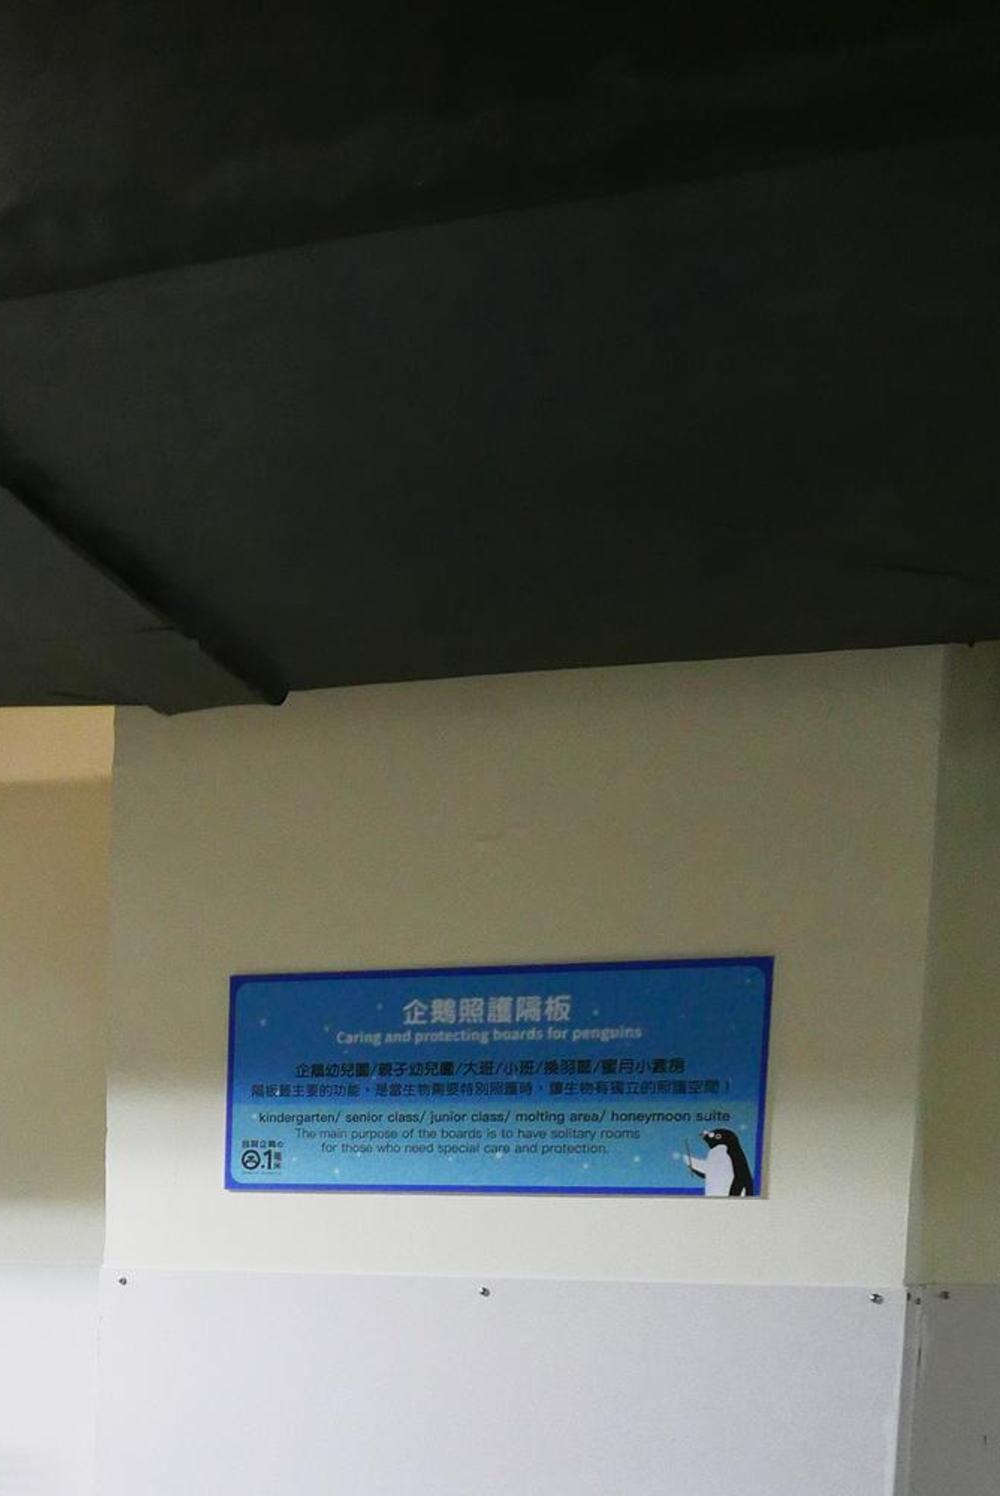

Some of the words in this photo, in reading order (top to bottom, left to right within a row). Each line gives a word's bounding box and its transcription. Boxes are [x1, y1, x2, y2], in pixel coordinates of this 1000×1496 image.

[402, 995, 572, 1025] 企鵝照護隔板
[336, 1031, 382, 1046] Caring
[385, 1030, 411, 1043] and
[414, 1028, 489, 1045] protecting
[493, 1027, 543, 1041] boards
[548, 1026, 567, 1039] for
[572, 1025, 642, 1042] penguins
[258, 1112, 341, 1124] kindergarten/
[345, 1112, 383, 1123] senior
[387, 1111, 425, 1123] class/
[430, 1111, 466, 1124] junior
[471, 1111, 510, 1123] class/
[515, 1110, 565, 1125] molting
[569, 1111, 606, 1122] area/
[611, 1110, 691, 1124] honeymoon
[695, 1110, 731, 1122] suite
[295, 1128, 316, 1139] The
[320, 1128, 347, 1139] main
[351, 1129, 398, 1143] purpose
[402, 1128, 415, 1139] of
[418, 1128, 437, 1139] the
[441, 1128, 482, 1139] boards
[487, 1128, 497, 1139] is
[501, 1128, 513, 1139] to
[517, 1128, 547, 1139] have
[551, 1128, 597, 1141] solitary
[600, 1129, 641, 1139] rooms
[321, 1143, 337, 1154] for
[341, 1143, 372, 1154] those
[376, 1143, 401, 1154] who
[405, 1143, 434, 1154] need
[438, 1143, 481, 1156] special
[484, 1145, 510, 1154] care
[514, 1143, 538, 1154] and
[541, 1143, 608, 1156] protection.
